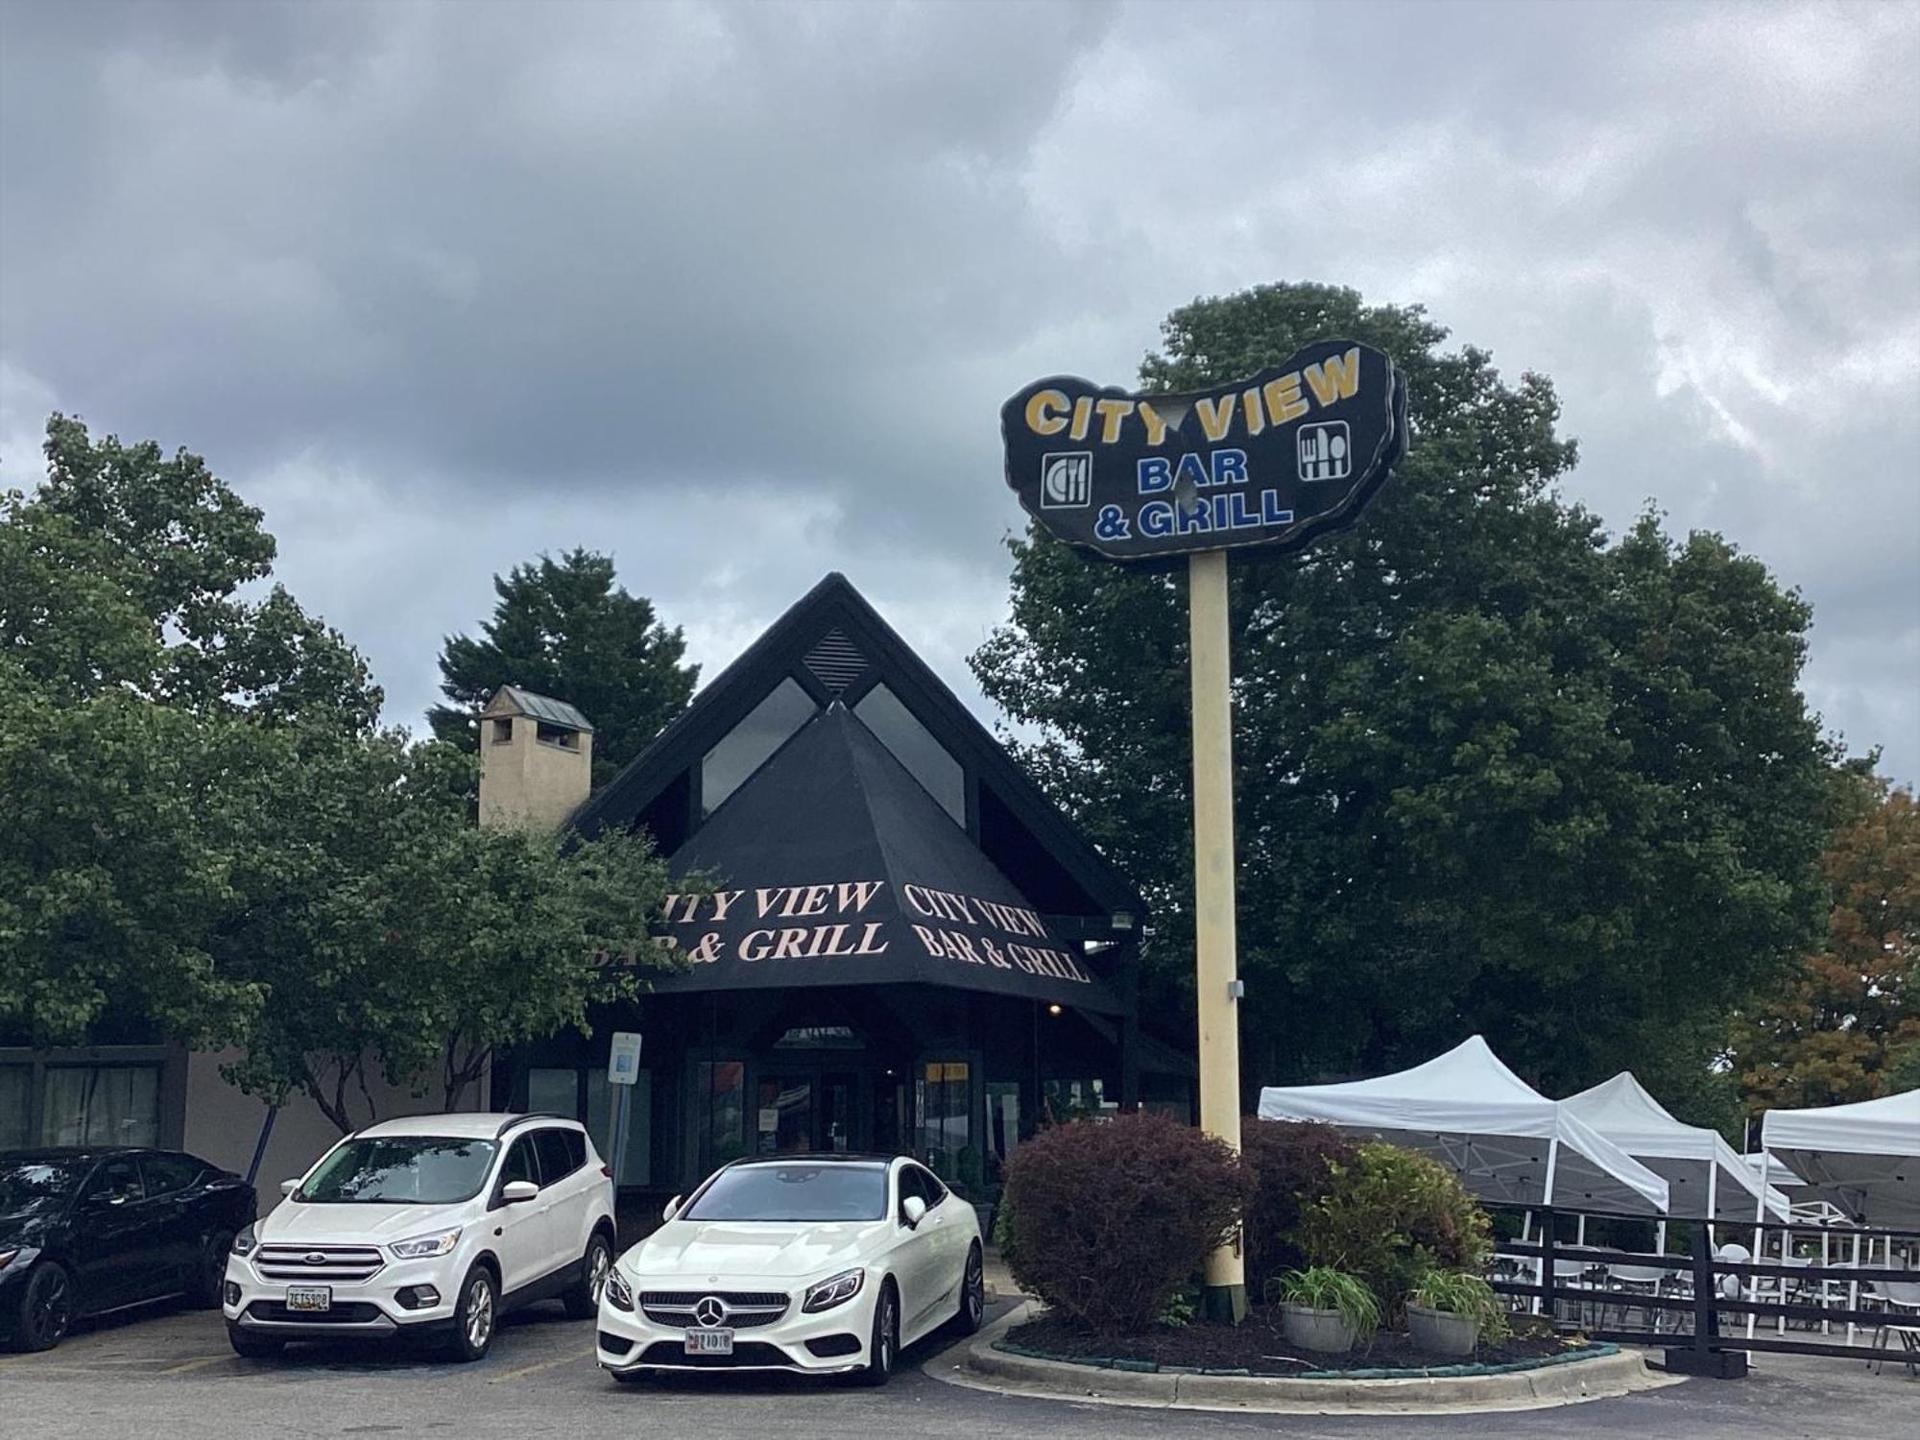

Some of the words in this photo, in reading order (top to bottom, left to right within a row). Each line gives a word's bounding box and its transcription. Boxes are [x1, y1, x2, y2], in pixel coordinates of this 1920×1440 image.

[1025, 389, 1167, 446] CITY
[1195, 347, 1360, 442] VIEW
[1137, 448, 1249, 494] BAR
[1094, 504, 1132, 541] &
[1137, 489, 1294, 538] GRILL
[654, 890, 745, 923] ITY
[755, 881, 885, 919] VIEW
[904, 884, 978, 925] CITY
[971, 898, 1048, 939] VIEW
[687, 932, 726, 964] &
[738, 922, 890, 962] GRILL
[911, 924, 986, 965] BAR
[981, 937, 1012, 970] &
[1007, 942, 1091, 984] GRILL
